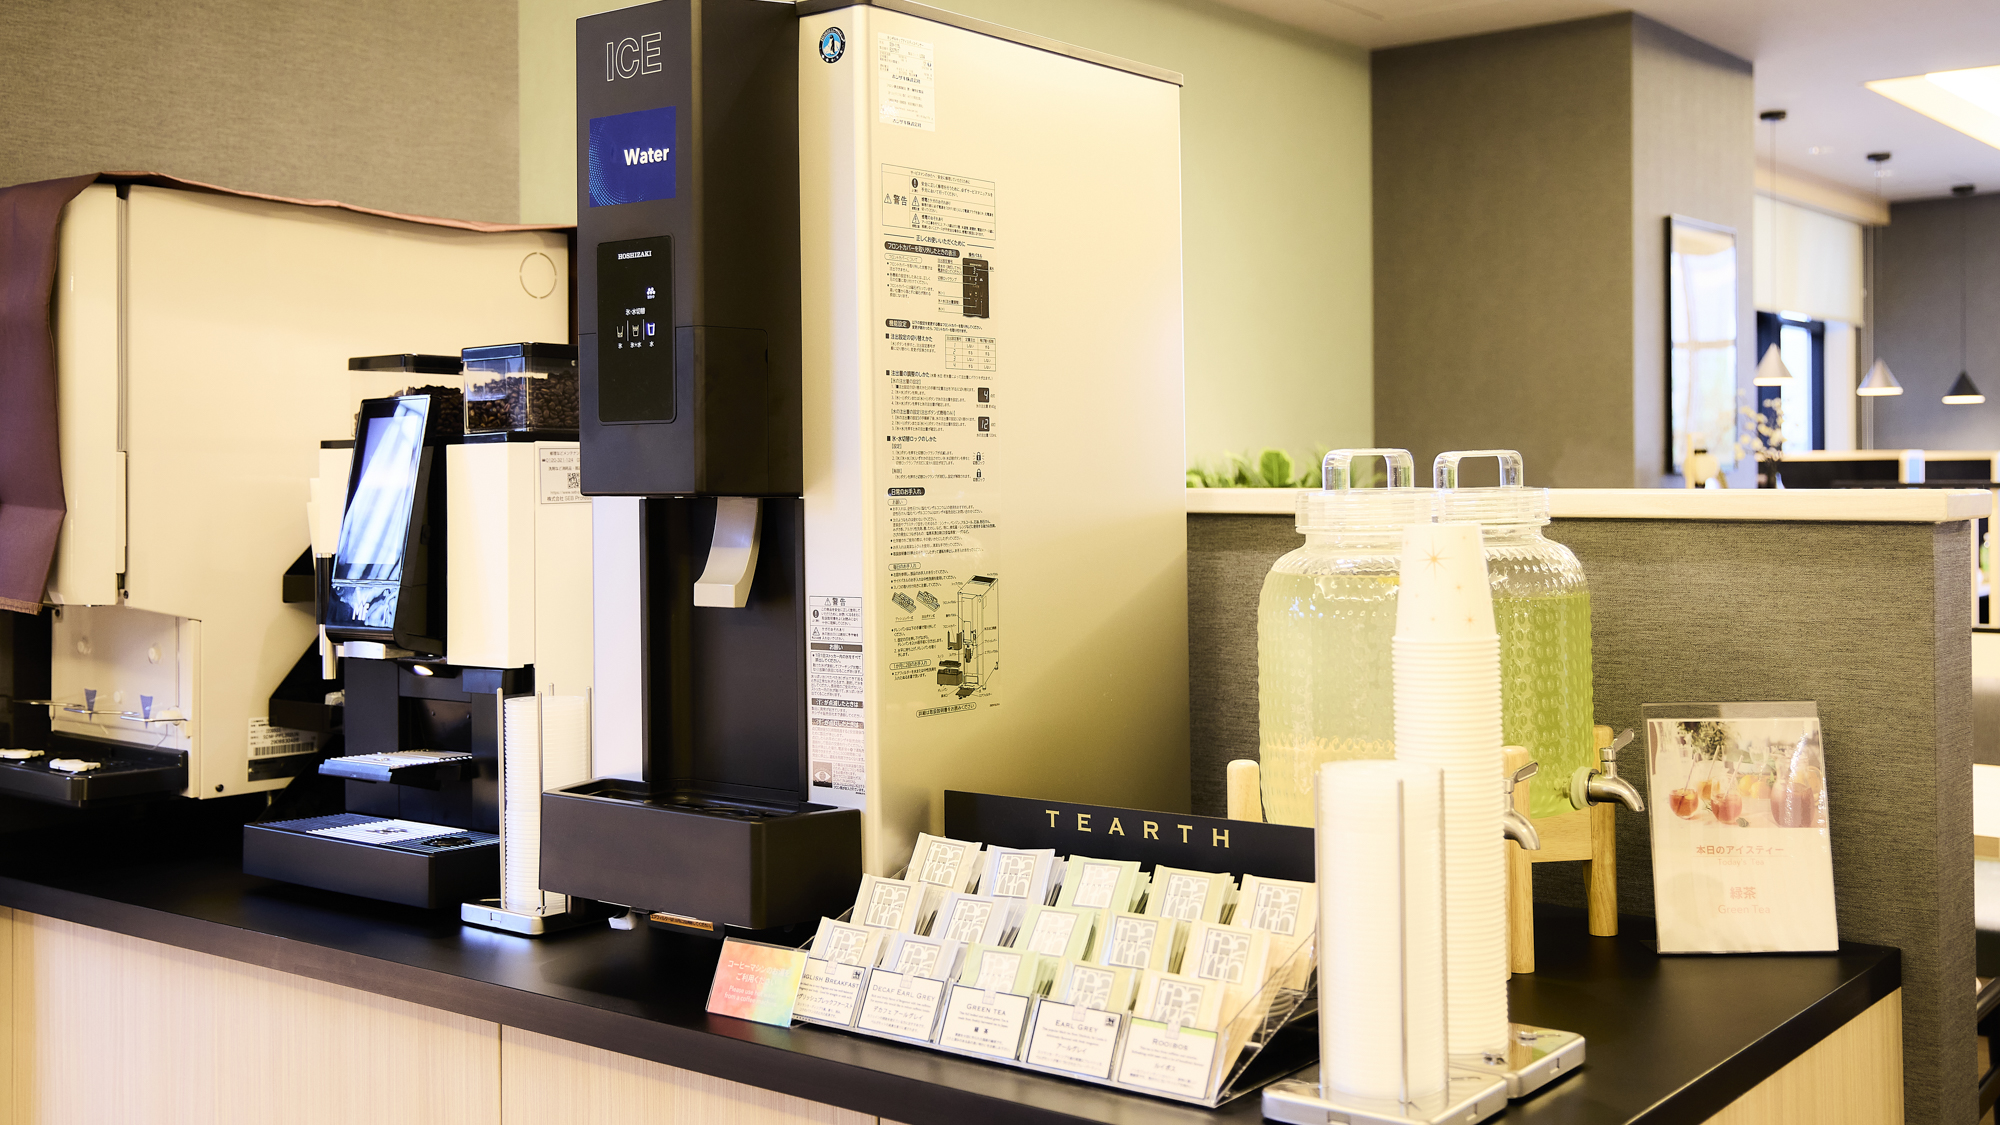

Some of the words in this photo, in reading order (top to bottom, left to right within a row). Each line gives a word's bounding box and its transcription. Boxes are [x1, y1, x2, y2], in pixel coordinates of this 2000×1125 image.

[606, 32, 662, 82] ICE
[624, 147, 670, 166] Water
[893, 194, 907, 206] 警告
[618, 251, 652, 260] HOSHIZAKI
[832, 597, 846, 606] 警告
[1045, 809, 1230, 848] TEARTH
[1696, 845, 1784, 855] 本日のアイスティー
[1718, 858, 1747, 866] Today's
[1751, 858, 1764, 866] Tea
[1729, 886, 1756, 900] 緑茶
[1718, 904, 1749, 914] Green
[1752, 904, 1771, 914] Tea
[825, 977, 860, 989] BREAKFAST
[729, 985, 744, 994] Please
[745, 988, 754, 996] use
[872, 984, 895, 996] DECAF
[896, 988, 914, 1000] EARL
[916, 992, 936, 1003] GREY
[966, 1003, 991, 1013] GREEN
[993, 1008, 1006, 1016] TEA
[1055, 1019, 1076, 1028] EARL
[1077, 1023, 1098, 1033] GREY
[1152, 1038, 1189, 1051] ROOIBOS
